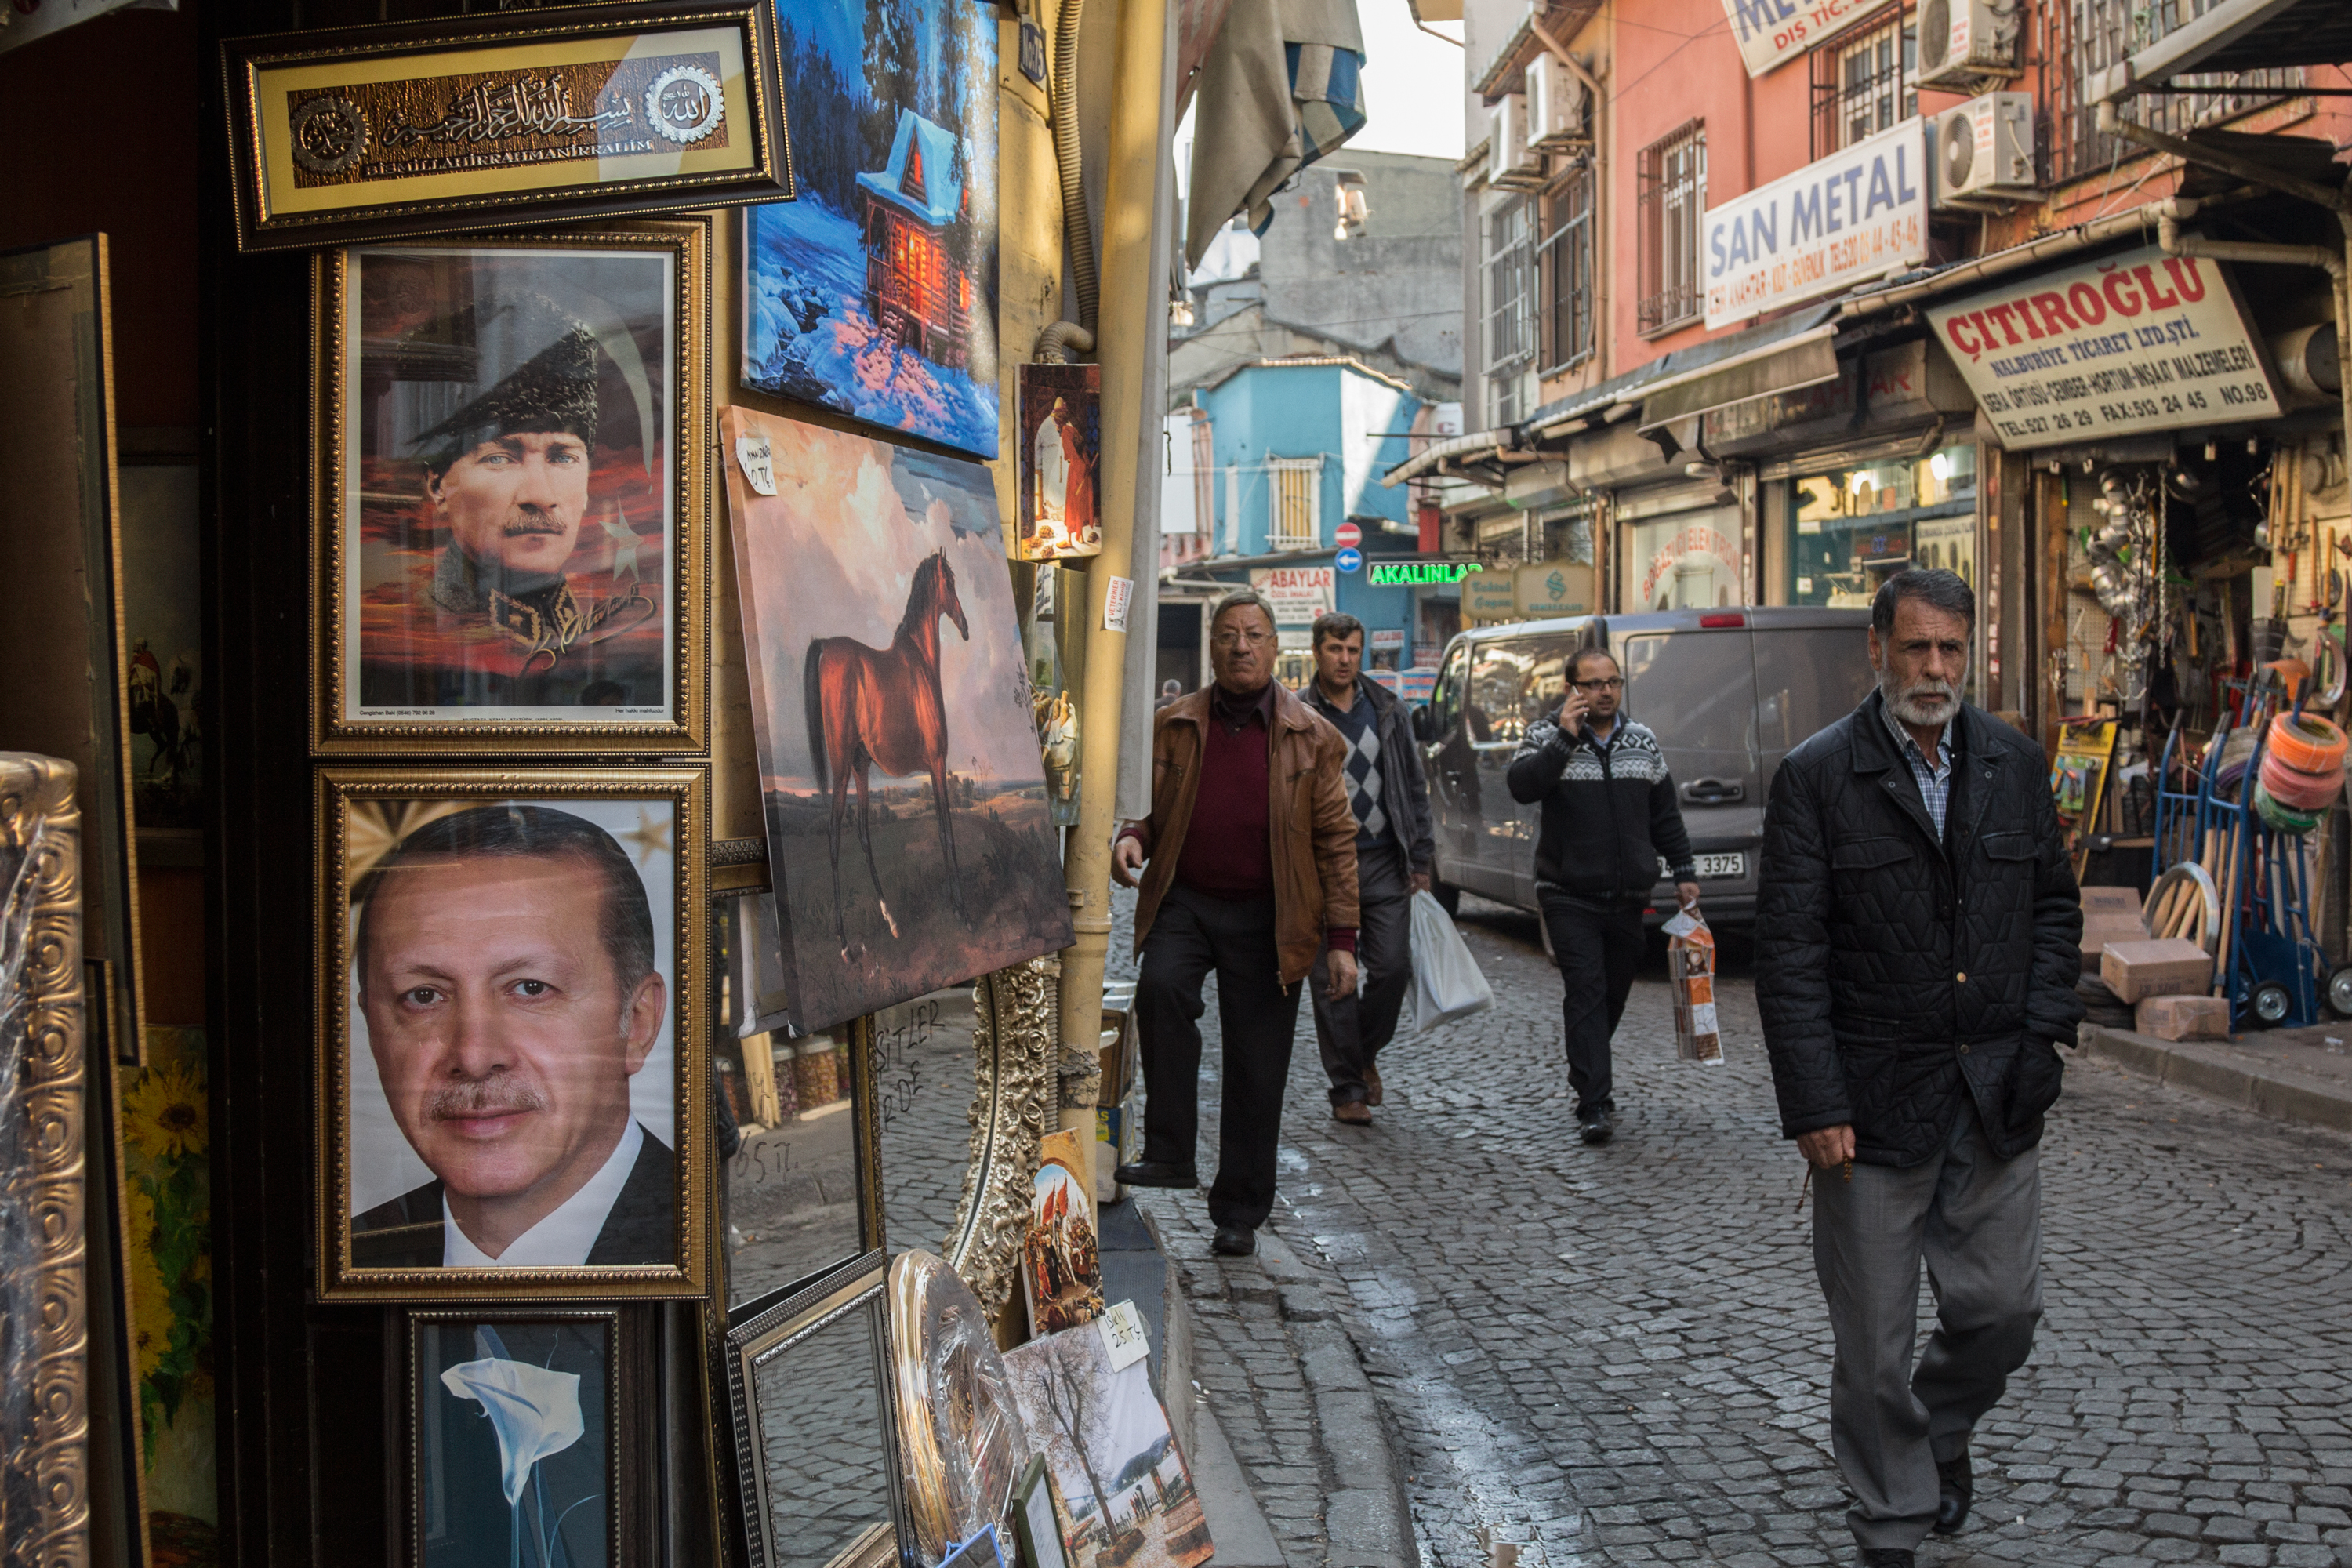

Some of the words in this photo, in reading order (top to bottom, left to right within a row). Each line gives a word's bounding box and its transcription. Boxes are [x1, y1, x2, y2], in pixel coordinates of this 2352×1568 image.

[1711, 200, 1777, 278] SAN
[1791, 143, 1916, 247] METAL
[1947, 256, 2205, 364] ÇITIROĞLU
[1990, 346, 2069, 379] NALBURİYE
[2067, 332, 2133, 361] TİCARET
[2171, 339, 2256, 380] MALZEMELERİ
[2052, 412, 2073, 430] 26
[2074, 408, 2094, 426] 29
[2161, 394, 2183, 413] 24
[2187, 390, 2208, 410] 45
[2219, 382, 2269, 405] NO.98
[1109, 579, 1119, 616] VETERİNER
[1270, 570, 1331, 588] ABAYLAR
[1704, 855, 1740, 873] 3375
[1112, 1330, 1127, 1348] 25
